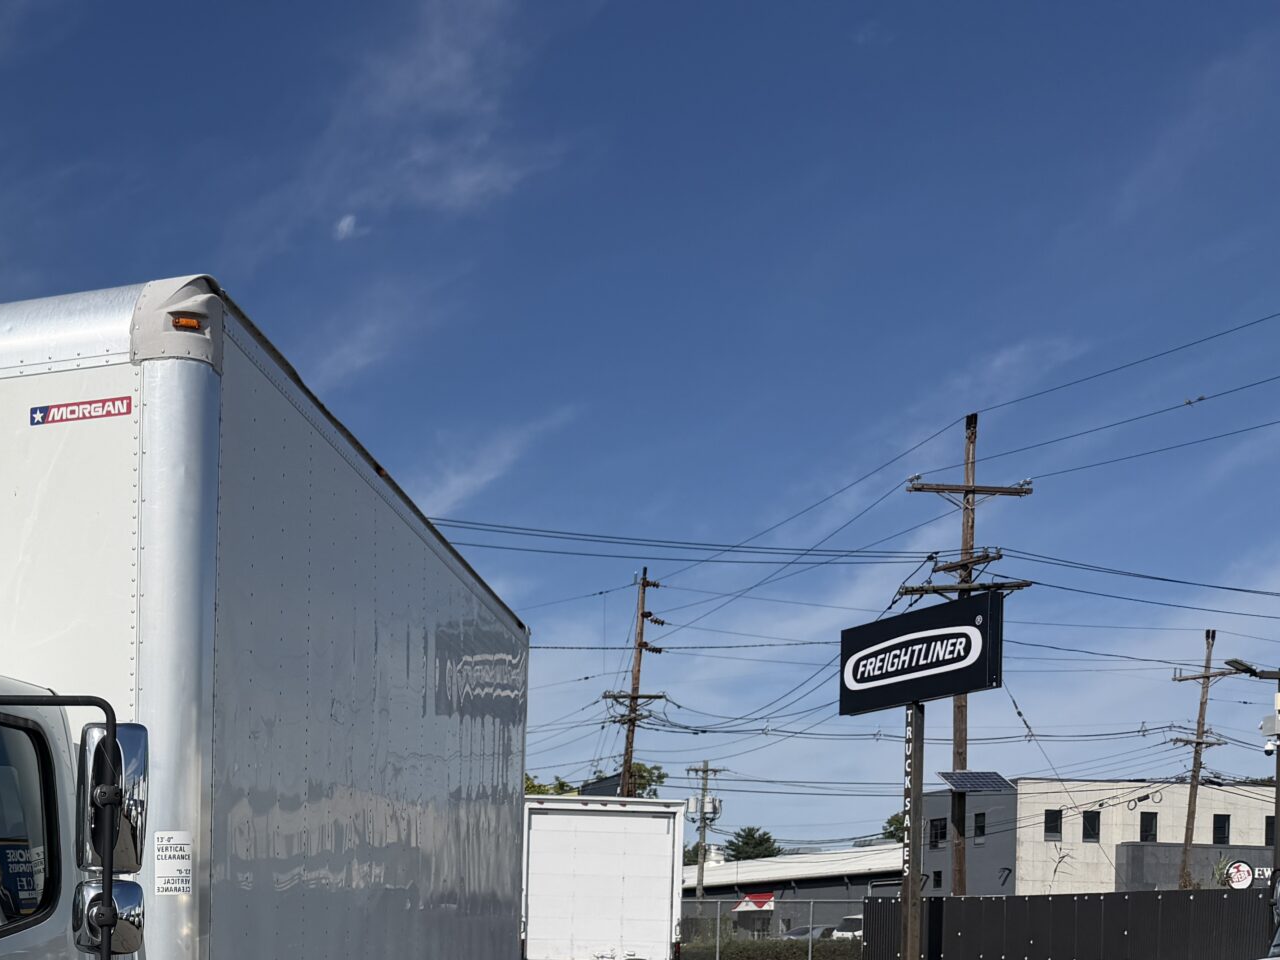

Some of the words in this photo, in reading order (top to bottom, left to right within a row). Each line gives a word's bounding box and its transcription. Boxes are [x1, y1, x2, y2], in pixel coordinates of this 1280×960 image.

[47, 399, 128, 422] MORGAN
[856, 636, 967, 680] FREIGHTLINER
[904, 709, 913, 789] TRUCK
[156, 845, 186, 853] VERTICAL
[903, 797, 911, 876] SALES
[156, 853, 191, 861] CLEARANCE
